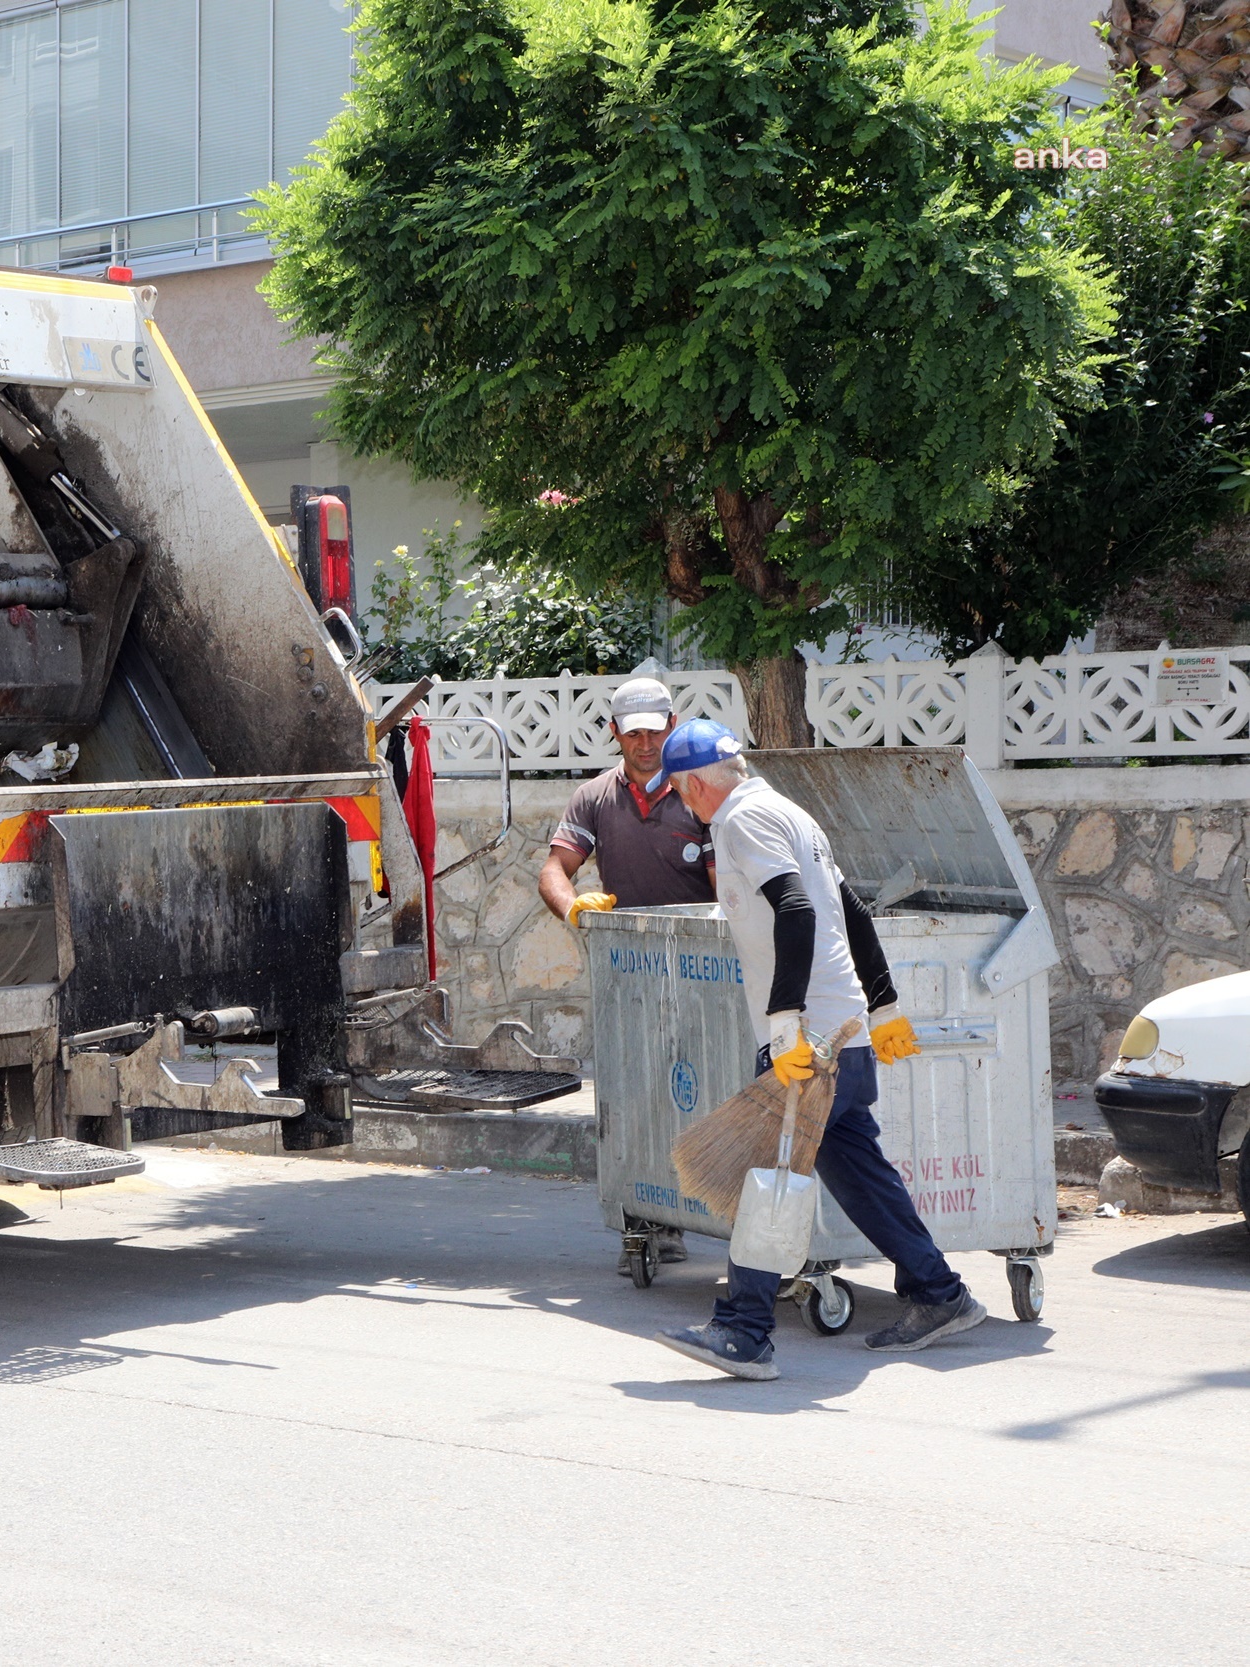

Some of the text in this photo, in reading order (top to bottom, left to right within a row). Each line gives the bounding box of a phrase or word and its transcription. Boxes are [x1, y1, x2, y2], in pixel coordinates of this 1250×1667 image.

[110, 344, 151, 383] CE
[1177, 657, 1216, 665] BURSAGAZ
[610, 947, 670, 977] MUDANYA
[920, 1157, 943, 1181] VE
[952, 1154, 985, 1179] KÜL
